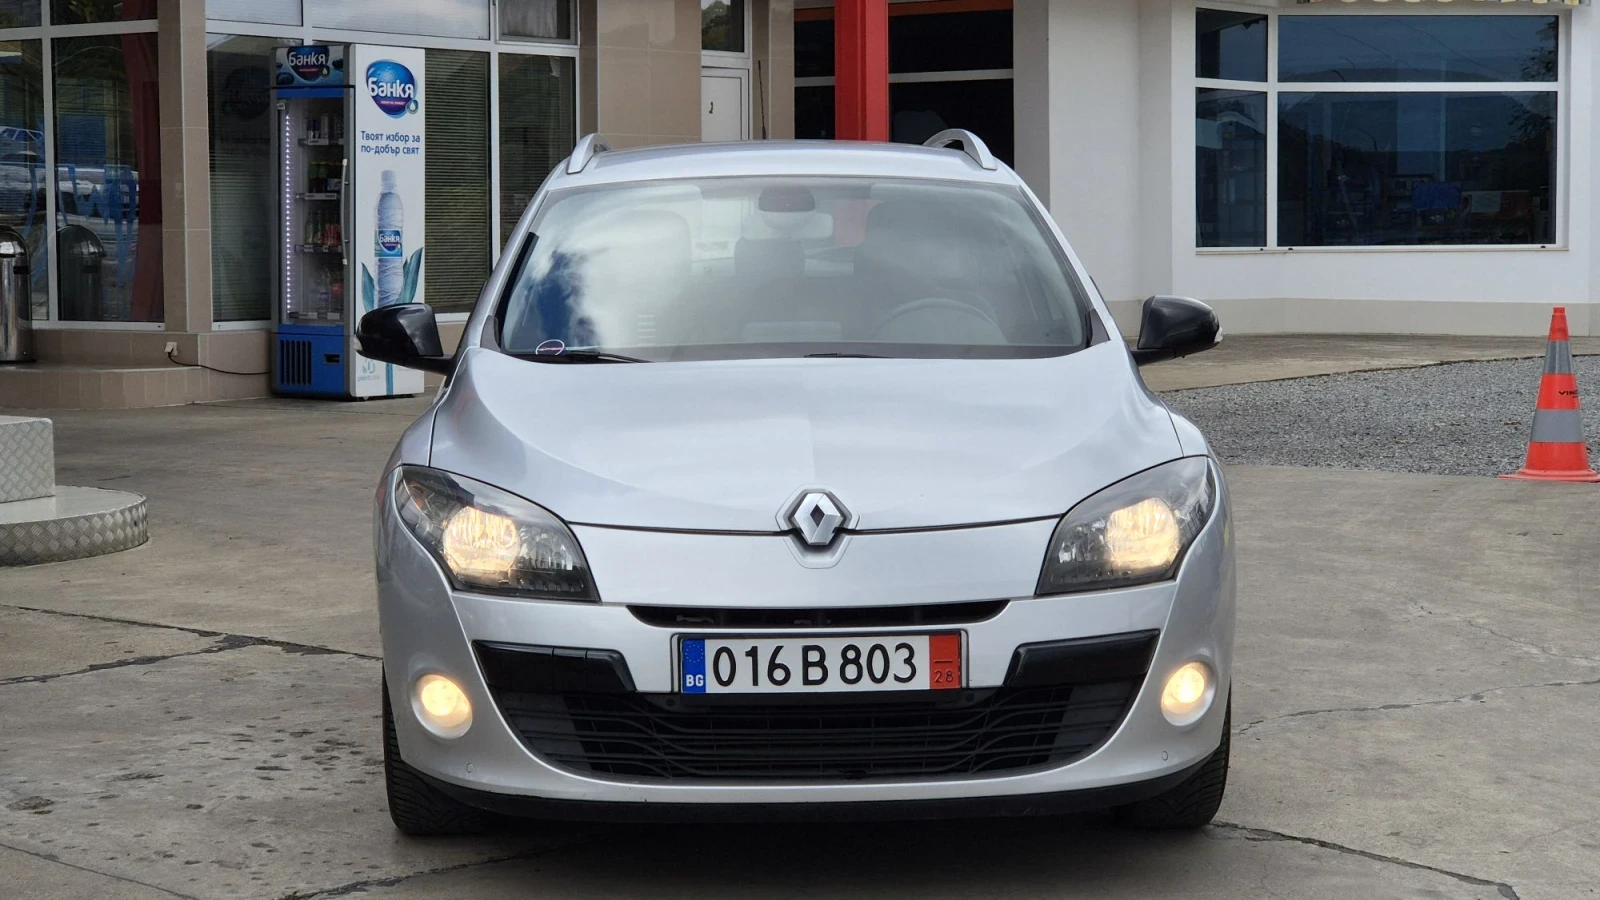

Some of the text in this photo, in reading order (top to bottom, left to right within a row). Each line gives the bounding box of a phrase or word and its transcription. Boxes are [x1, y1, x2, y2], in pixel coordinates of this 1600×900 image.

[361, 130, 421, 144] Твоят избор за
[361, 144, 420, 156] по-добър свят
[686, 675, 704, 687] BG
[934, 669, 954, 683] 28
